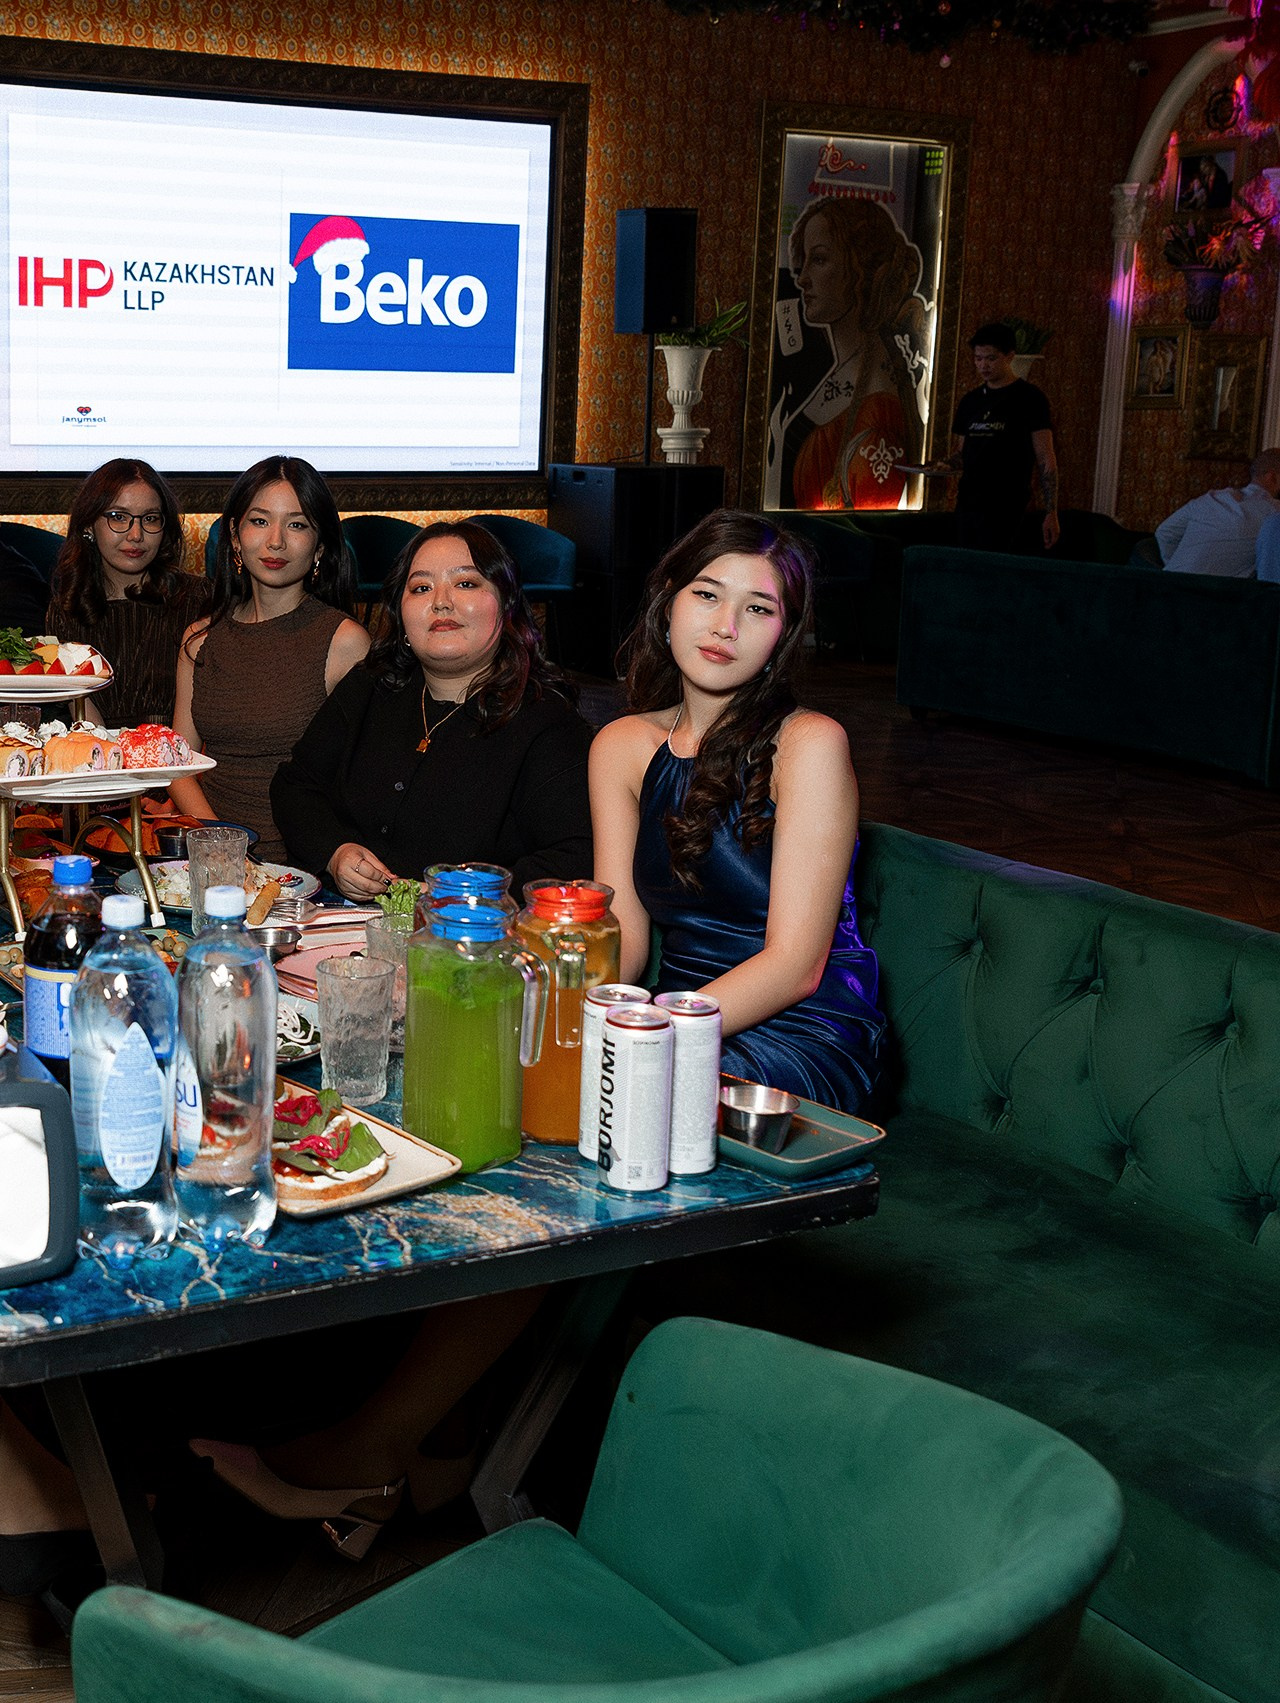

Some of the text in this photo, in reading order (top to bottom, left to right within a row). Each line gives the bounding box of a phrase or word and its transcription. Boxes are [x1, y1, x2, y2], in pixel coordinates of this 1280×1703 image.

[18, 256, 275, 308] IHP KAZAKHSTAN
[123, 290, 165, 311] LLP
[320, 258, 488, 328] Beko
[597, 1037, 616, 1172] BORJOMI
